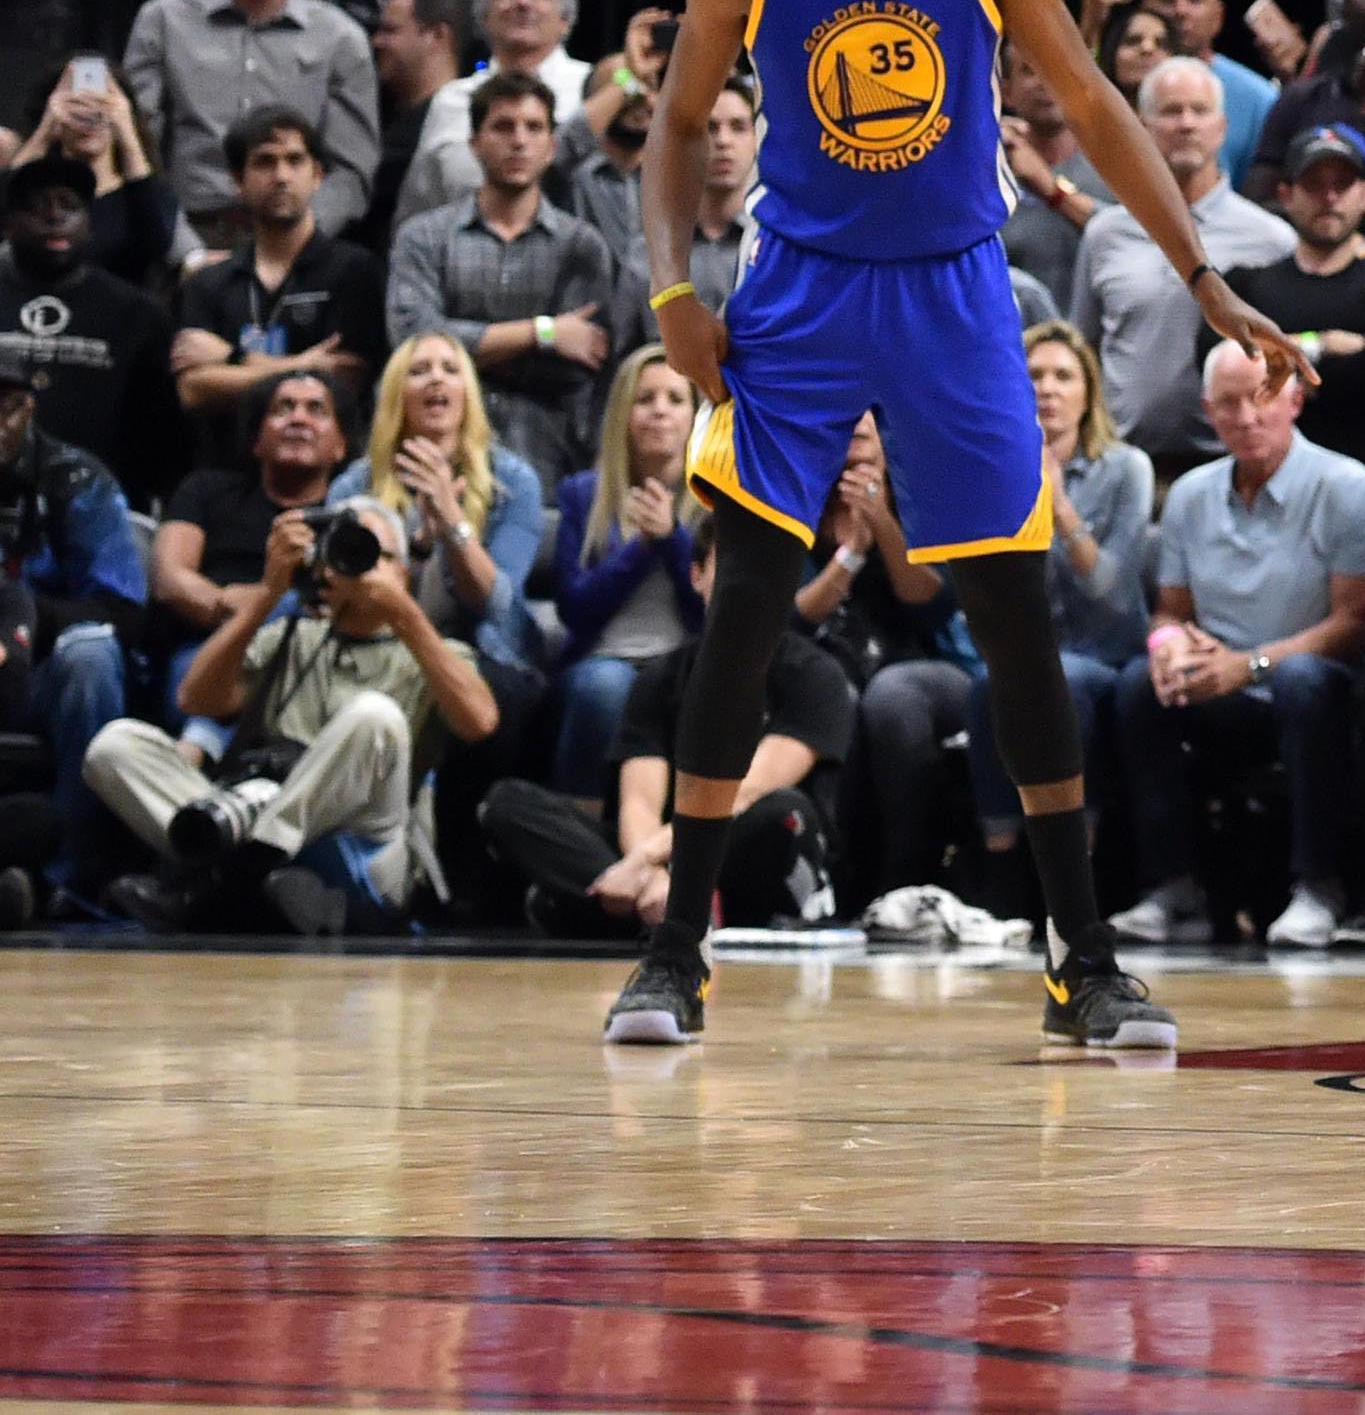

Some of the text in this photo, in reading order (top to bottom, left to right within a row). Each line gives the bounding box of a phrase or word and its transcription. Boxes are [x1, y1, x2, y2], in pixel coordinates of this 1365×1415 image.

[803, 0, 942, 53] GOLDEN STATE
[869, 39, 916, 75] 35
[819, 112, 952, 172] WARRIORS
